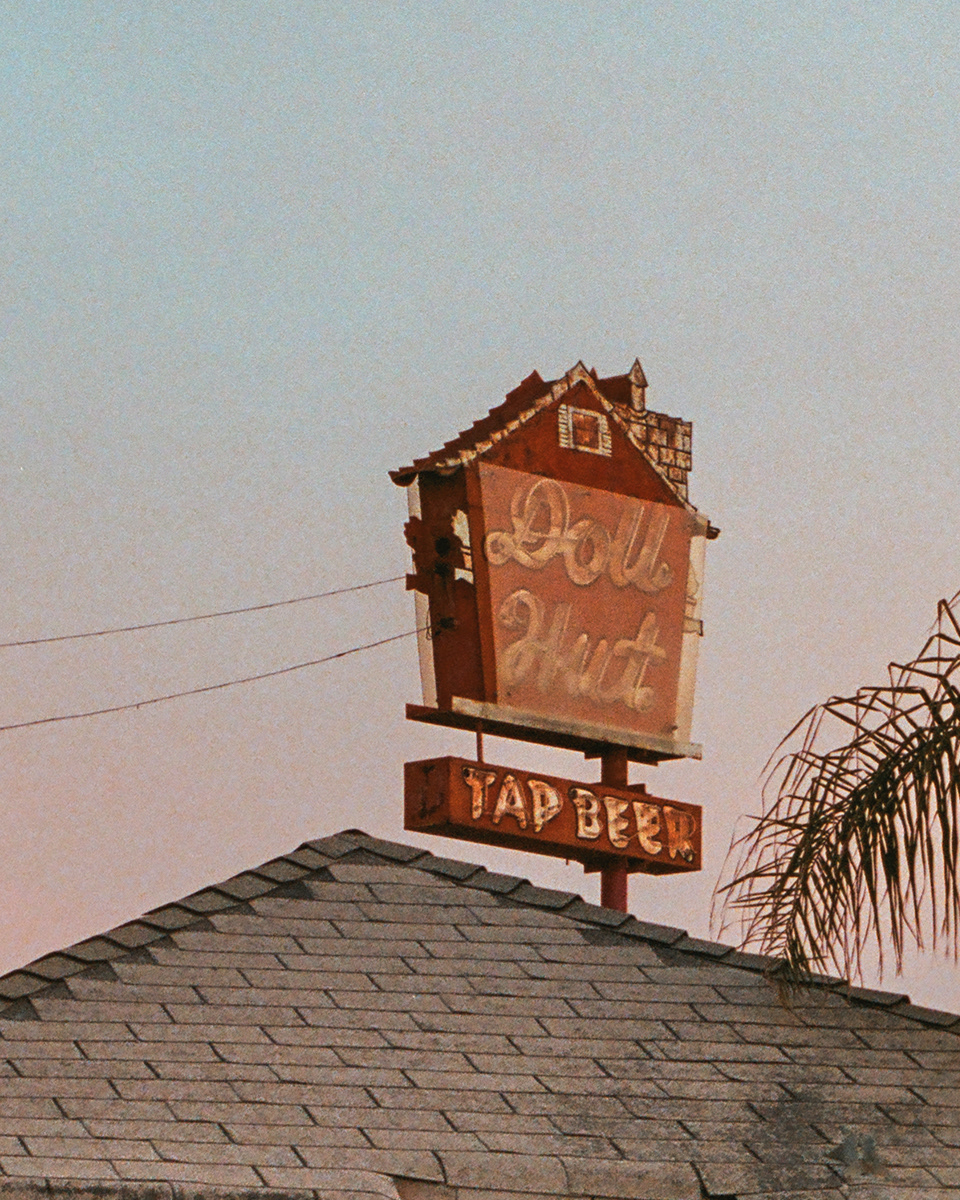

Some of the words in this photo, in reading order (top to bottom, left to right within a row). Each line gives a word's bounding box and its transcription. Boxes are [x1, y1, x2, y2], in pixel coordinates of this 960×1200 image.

[485, 479, 673, 595] Doll
[497, 588, 668, 713] Hut
[462, 766, 563, 834] TAP
[569, 786, 696, 863] BEER
